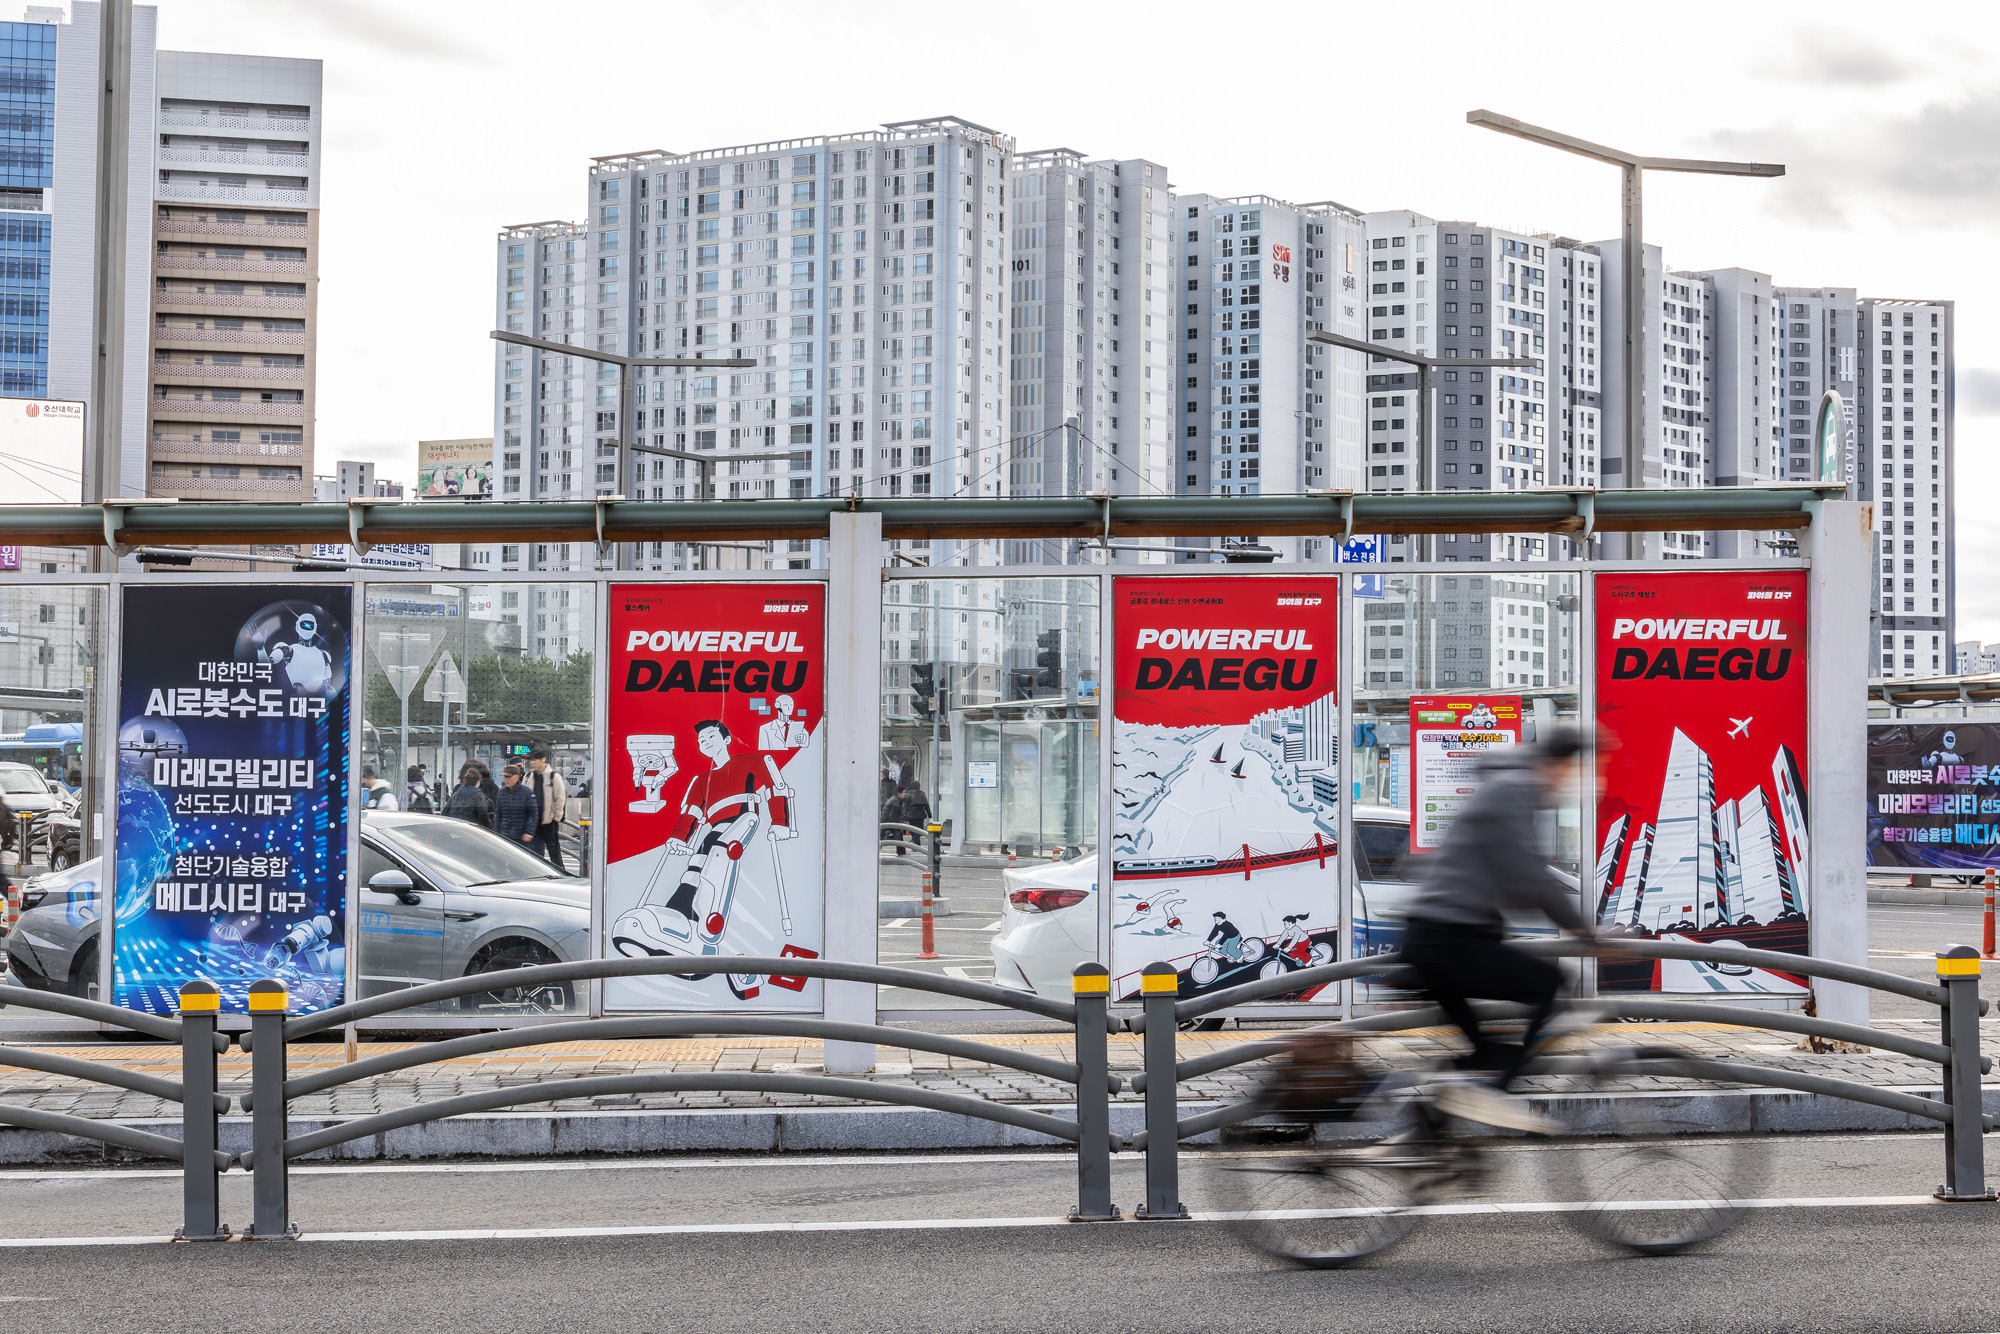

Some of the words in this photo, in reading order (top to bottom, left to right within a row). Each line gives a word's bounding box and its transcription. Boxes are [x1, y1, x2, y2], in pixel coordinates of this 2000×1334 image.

[1273, 243, 1290, 263] SM
[1012, 259, 1030, 272] 101
[1344, 305, 1354, 317] 105
[44, 404, 80, 413] 호산대학교
[428, 452, 459, 461] 대성에너지
[1344, 550, 1376, 563] 버스전용
[791, 604, 808, 612] 대구
[1136, 628, 1313, 650] POWERFUL
[1612, 618, 1787, 640] POWERFUL
[626, 630, 804, 653] POWERFUL
[198, 662, 273, 684] 대한민국
[1135, 657, 1318, 691] DAEGU
[1611, 647, 1792, 681] DAEGU
[624, 660, 809, 693] DAEGU
[144, 688, 284, 719] AI로봇수도
[289, 697, 327, 719] 대구
[1353, 723, 1377, 748] US
[1445, 734, 1459, 742] 택시
[1460, 733, 1476, 742] 우수
[153, 758, 314, 789] 미래모빌리티
[1887, 770, 1932, 784] 대한민국
[174, 795, 249, 815] 선도도시
[254, 795, 292, 816] 대구
[1878, 794, 1977, 814] 미래모빌리티
[1884, 827, 1953, 842] 첨단기술융합
[175, 856, 288, 878] 첨단기술융합
[156, 883, 263, 913] 메디시티
[269, 892, 307, 913] 대구
